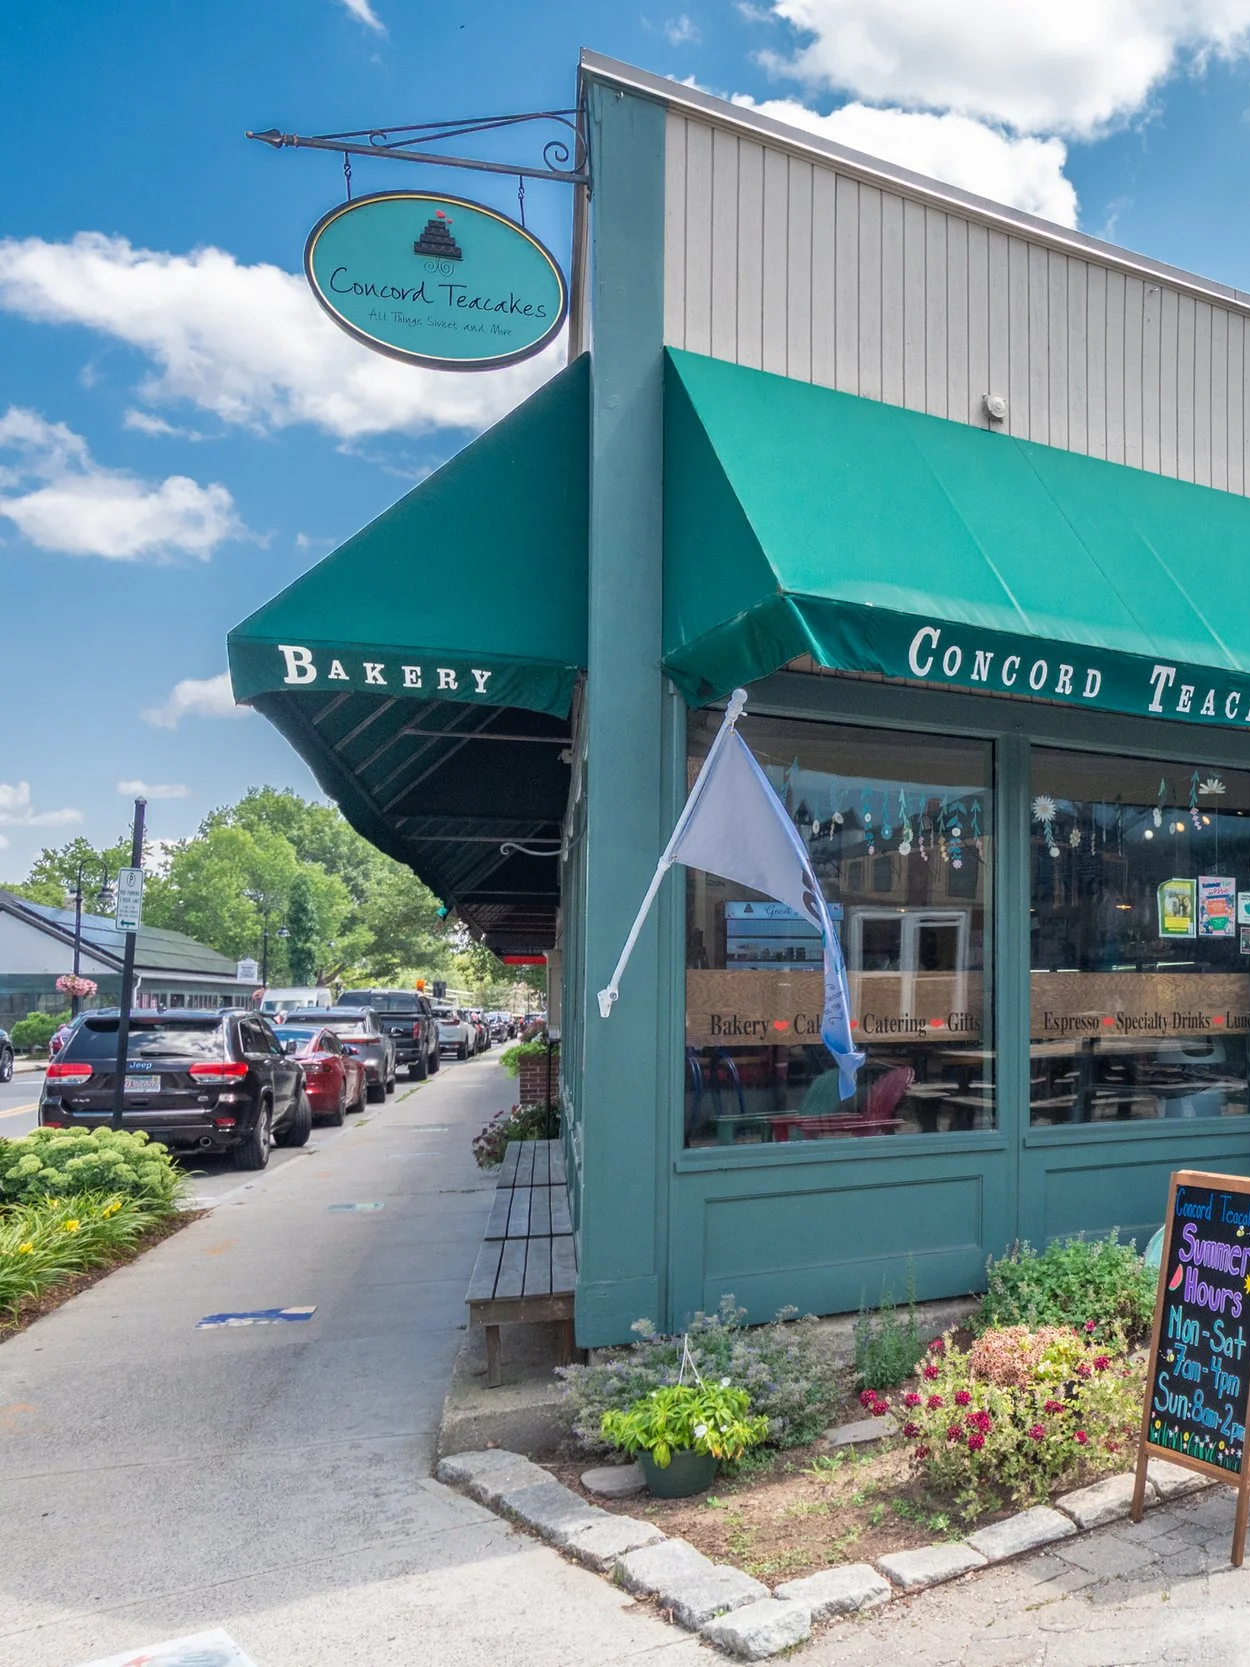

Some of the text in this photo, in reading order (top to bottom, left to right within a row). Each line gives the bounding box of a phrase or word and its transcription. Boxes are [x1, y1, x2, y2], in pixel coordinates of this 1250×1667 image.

[330, 267, 547, 318] Concord Teacakes
[368, 308, 513, 336] All Things Sweet and More
[278, 644, 492, 694] BAKERY
[908, 626, 1102, 698] CONCORD
[764, 904, 793, 918] Good
[709, 1014, 770, 1040] Bakery
[862, 1013, 927, 1038] Catering
[947, 1012, 981, 1032] Gifts
[1044, 1011, 1100, 1035] Espresso
[1115, 1011, 1169, 1034] Specialty
[1172, 1011, 1211, 1029] Drinks
[129, 1061, 153, 1070] Jeep
[1175, 1187, 1214, 1221] Concord
[1184, 1265, 1243, 1318] Hours
